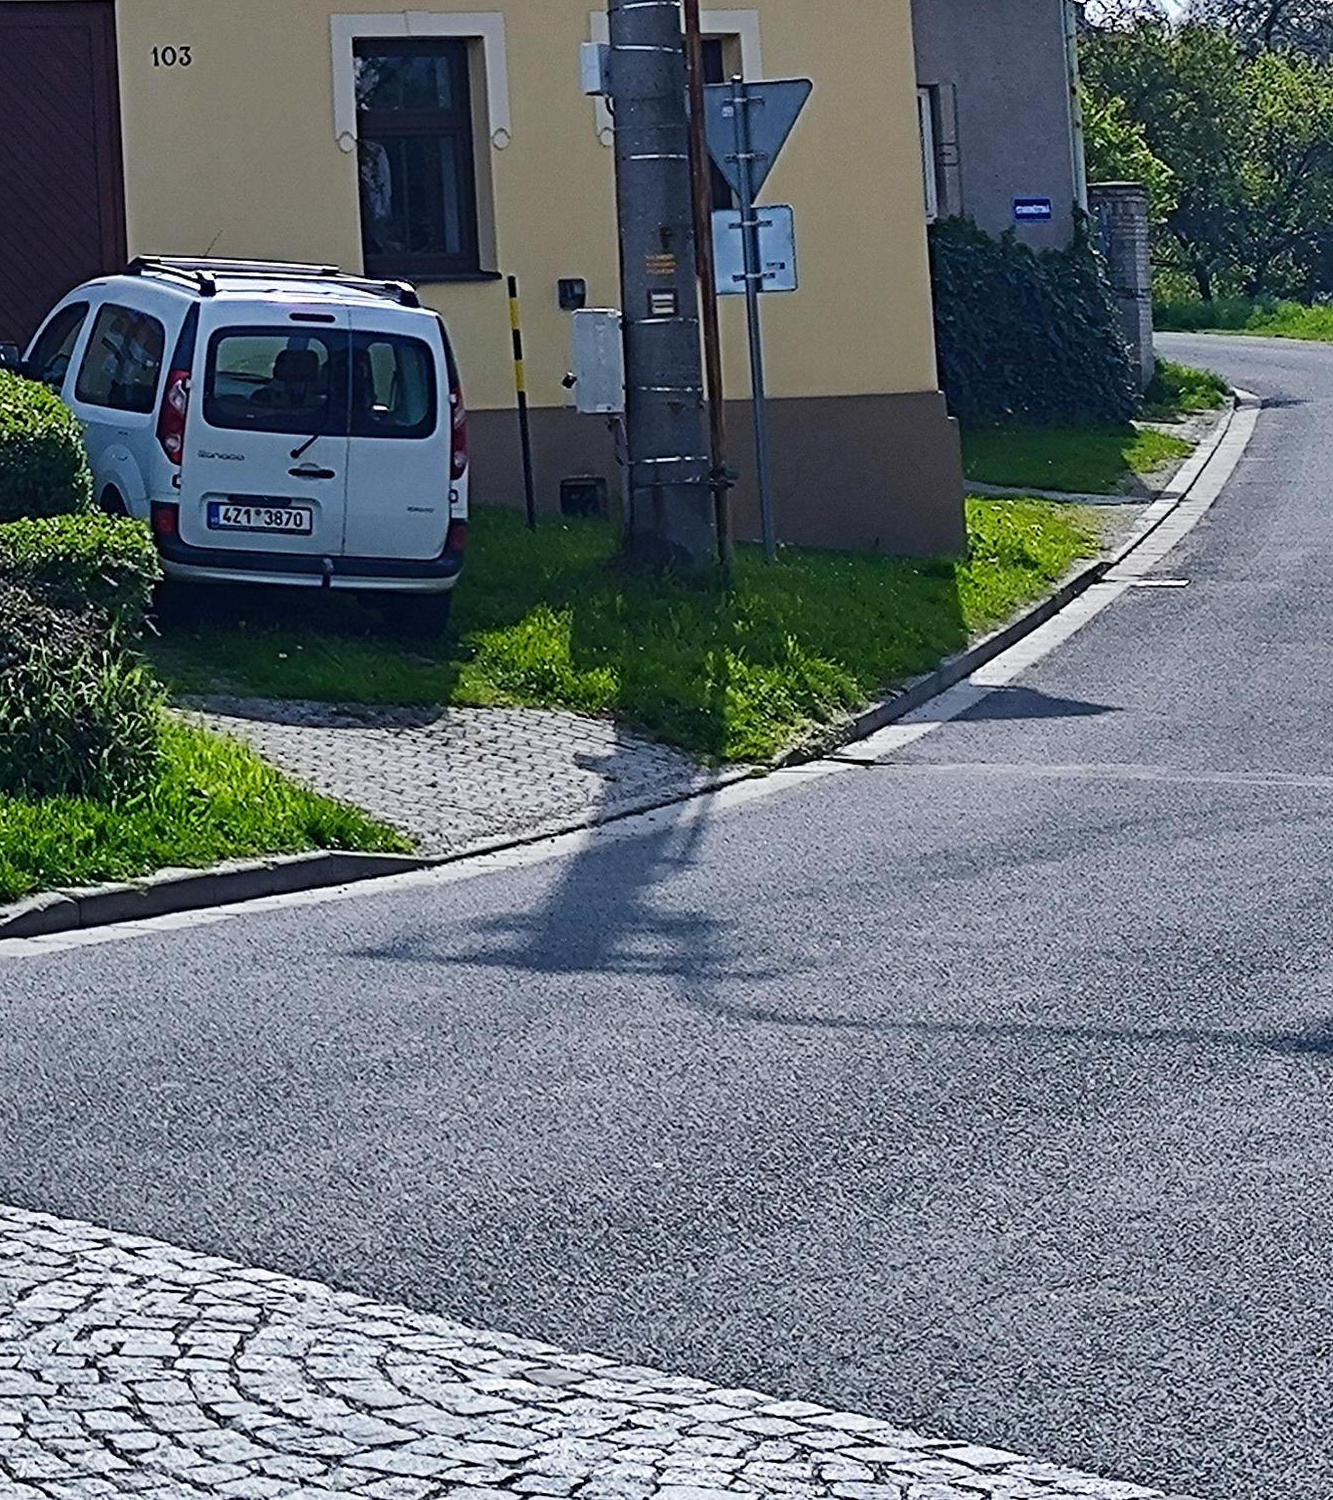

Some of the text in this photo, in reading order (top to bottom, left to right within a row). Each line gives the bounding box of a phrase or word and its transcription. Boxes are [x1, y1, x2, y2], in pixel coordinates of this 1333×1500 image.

[149, 46, 192, 67] 103
[222, 507, 303, 528] 4Z1 3870
